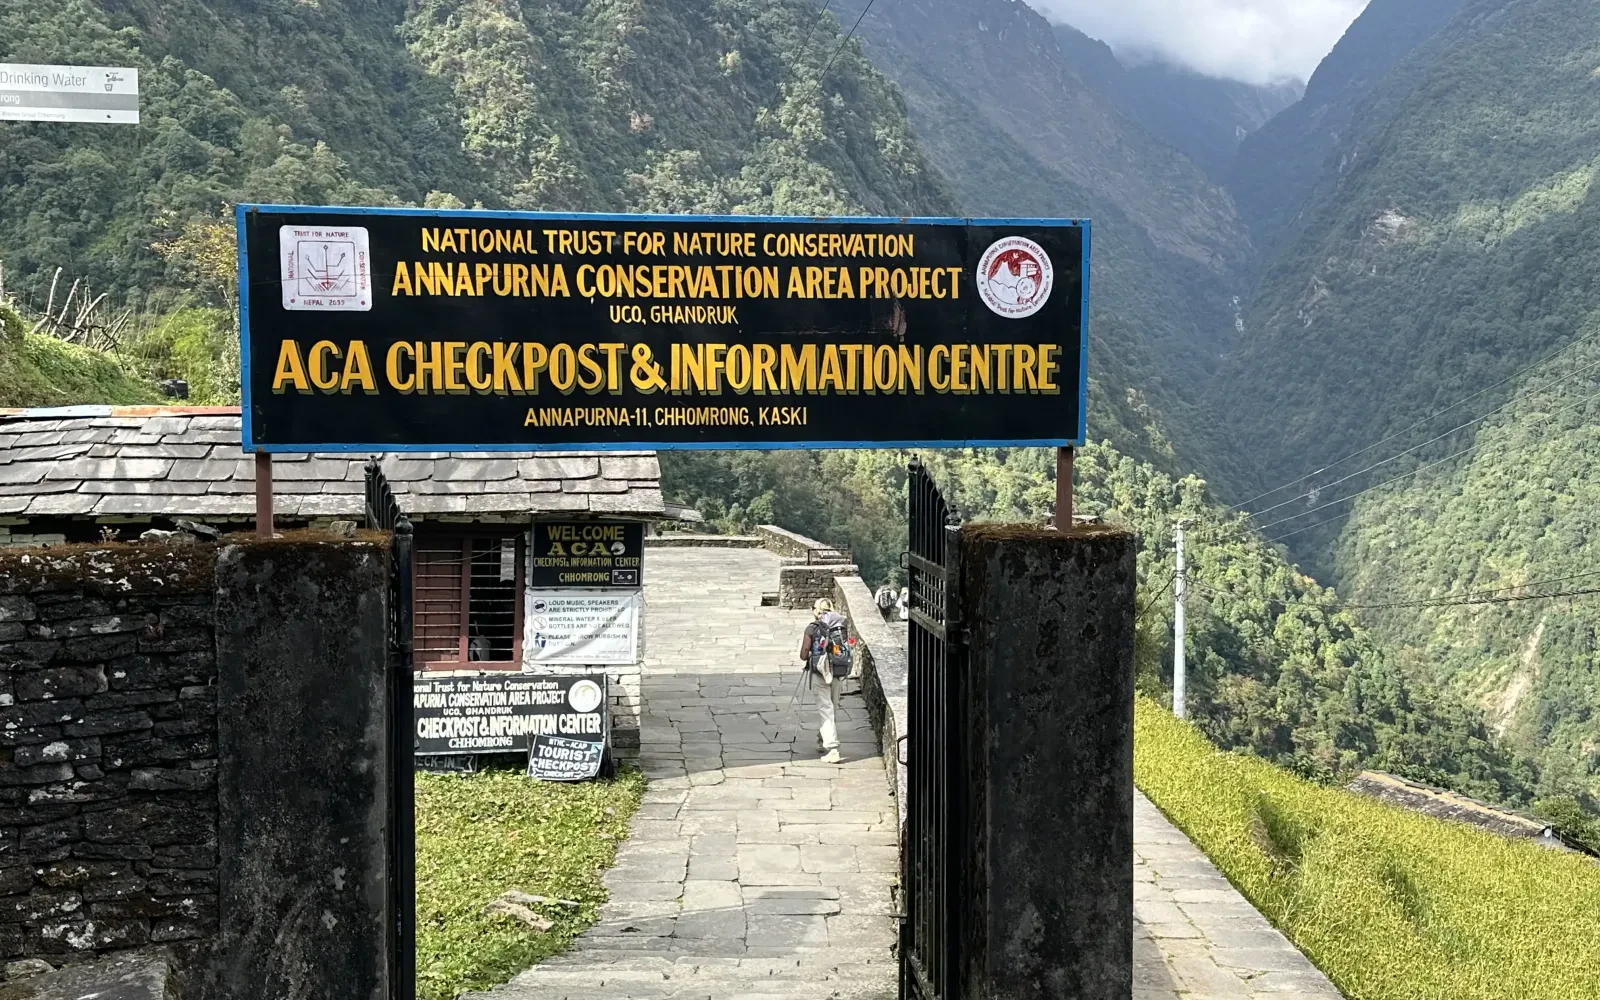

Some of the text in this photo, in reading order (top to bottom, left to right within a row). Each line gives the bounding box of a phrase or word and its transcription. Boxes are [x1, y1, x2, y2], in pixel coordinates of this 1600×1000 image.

[0, 71, 87, 88] Drinking Water
[325, 231, 349, 239] NATURE
[421, 227, 914, 258] NATIONAL TRUST FOR NATURE CONSERVATION
[287, 250, 295, 280] NATIONAL
[391, 261, 963, 300] ANNAPURNA CONSERVATION AREA PROJECT
[609, 305, 739, 326] UCO, GHANDRUK
[272, 338, 1062, 396] ACA CHECKPOST & INFORMATION CENTRE
[524, 406, 808, 428] ANNAPURNA-11, CHHOMRONG, KASKI
[547, 541, 612, 556] ACA
[571, 557, 612, 567] INFORMATION
[615, 557, 640, 567] CENTER
[559, 572, 610, 582] CHHOMRONG
[433, 681, 455, 693] Trust
[457, 680, 471, 692] for
[472, 680, 502, 692] Nature
[504, 679, 559, 691] Conservation
[414, 689, 566, 708] APURNA CONSERVATION AREA PROJECT
[465, 706, 513, 716] GHANDRUK
[417, 712, 601, 739] CHECKPOST & INFORMATION CENTER
[448, 736, 513, 749] CHHOMRONG
[538, 744, 591, 762] TOURIST
[530, 757, 598, 772] CHECKPOST
